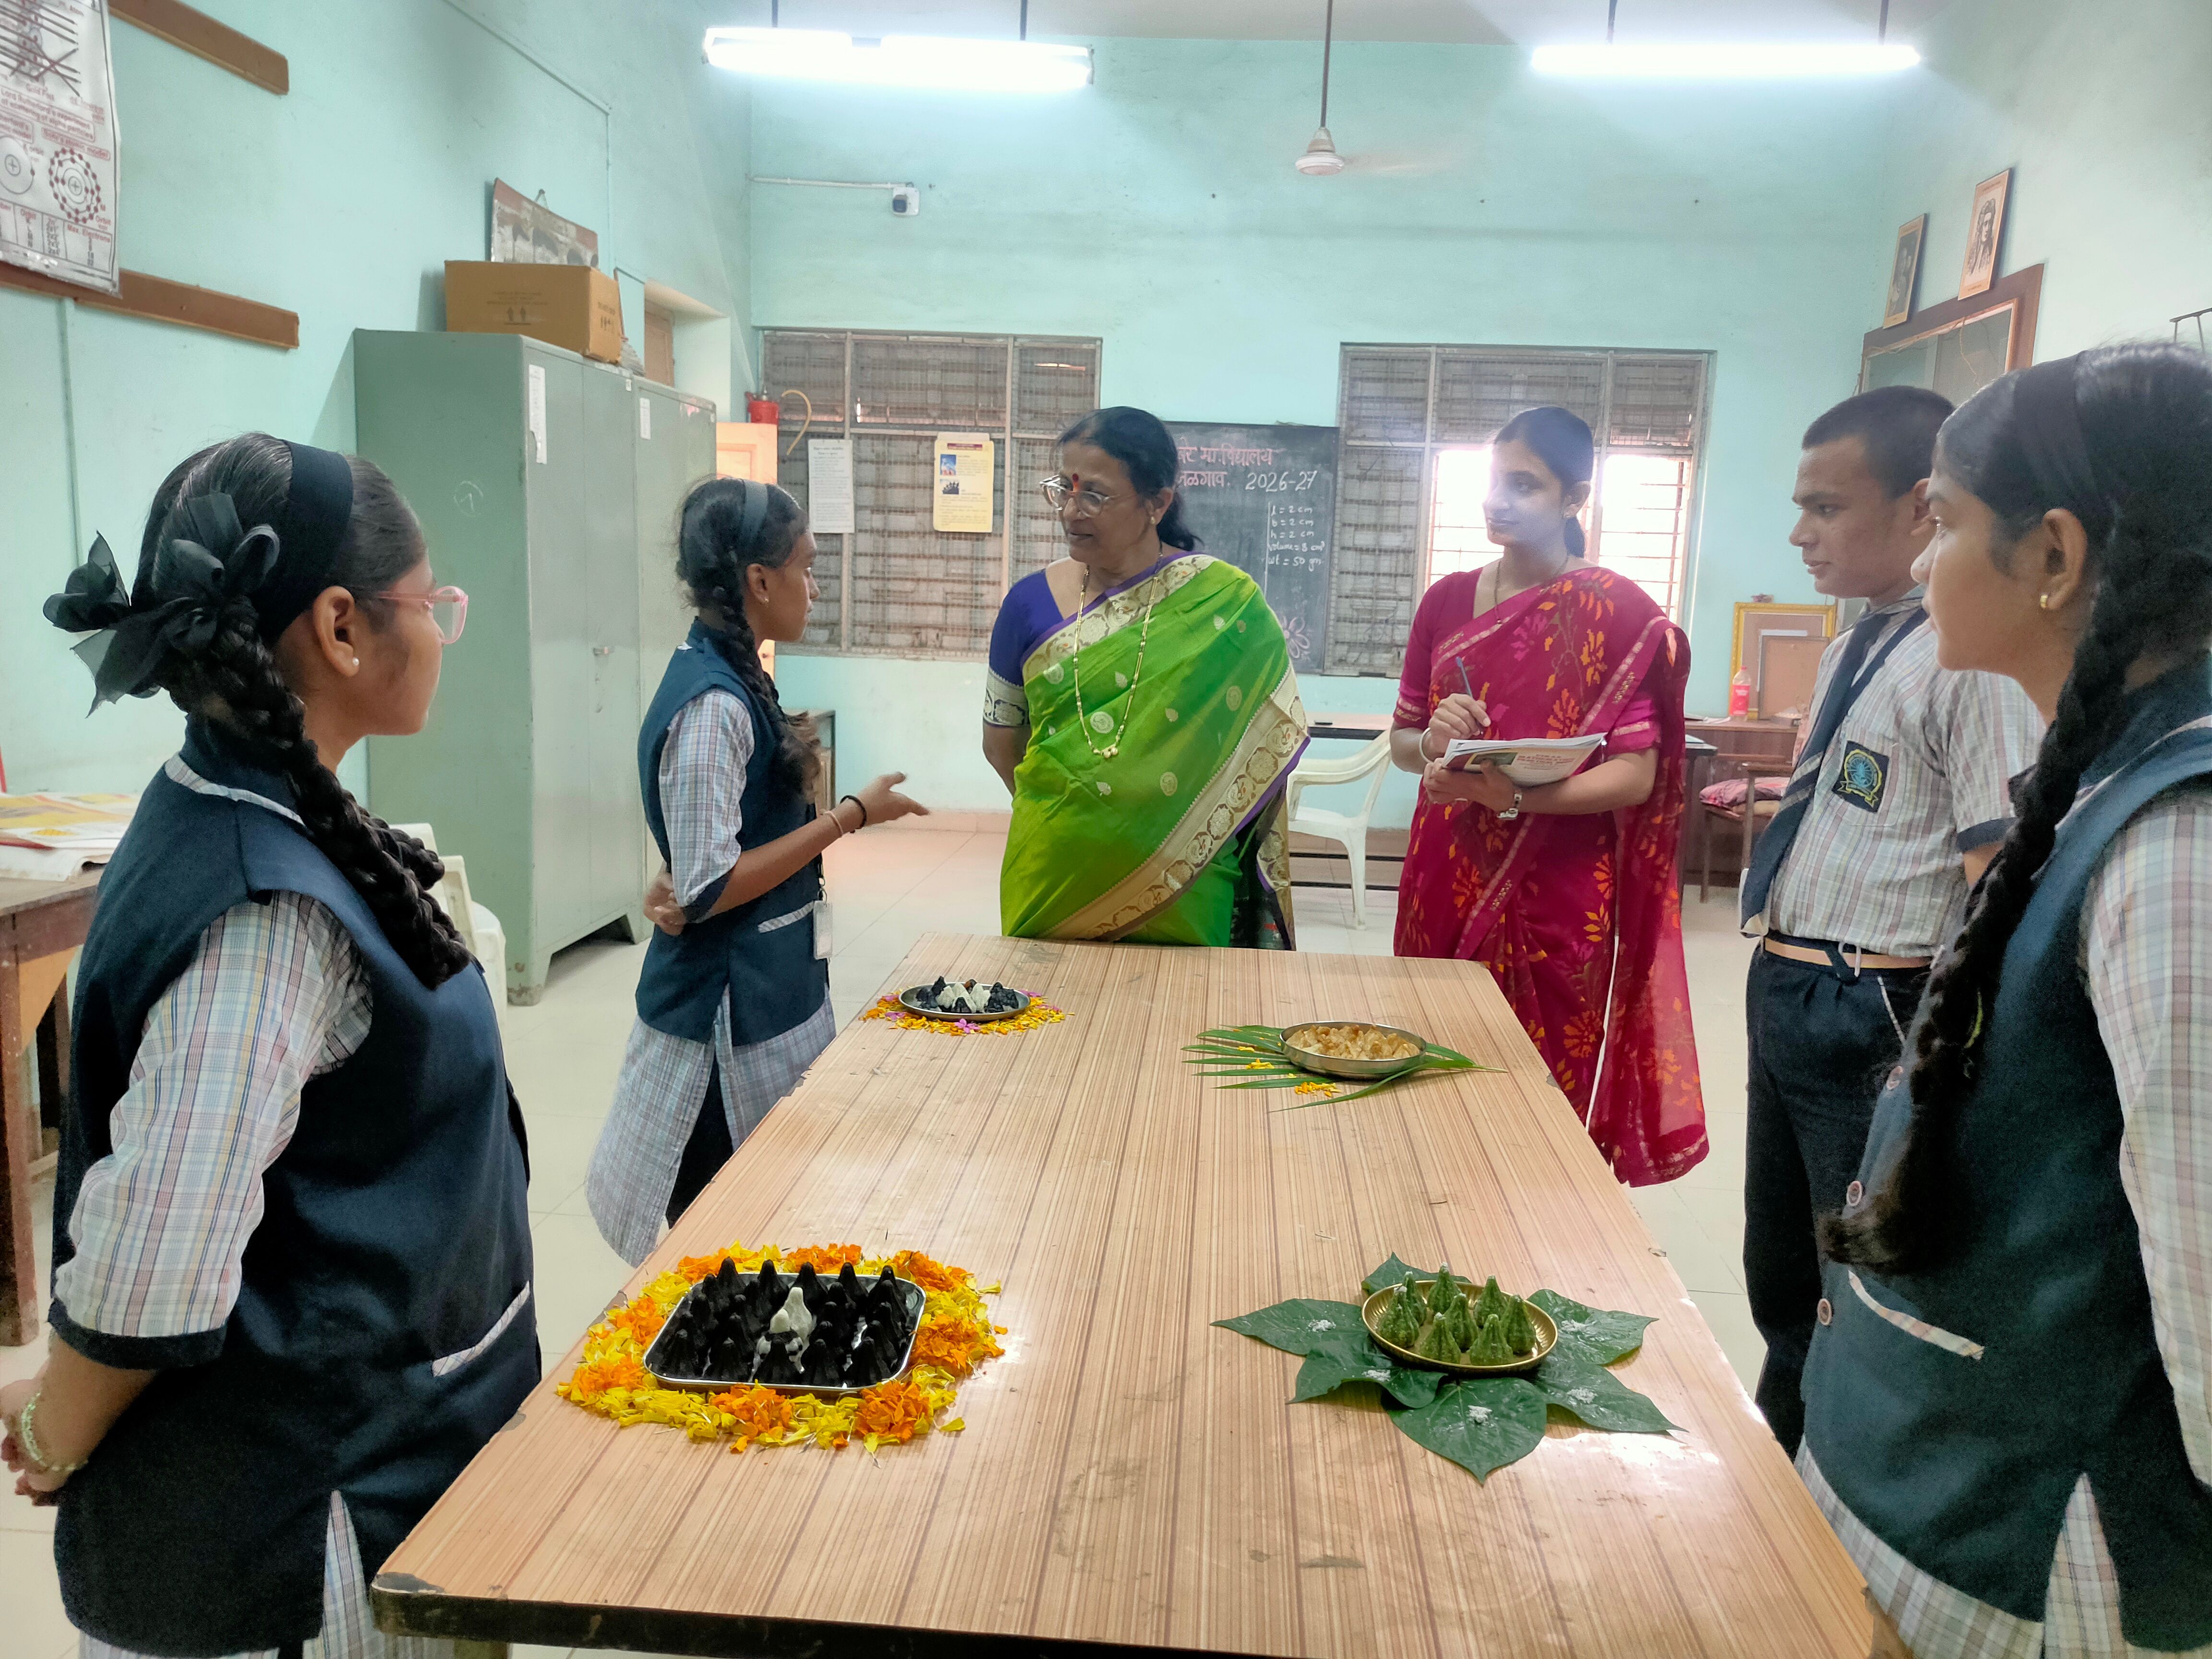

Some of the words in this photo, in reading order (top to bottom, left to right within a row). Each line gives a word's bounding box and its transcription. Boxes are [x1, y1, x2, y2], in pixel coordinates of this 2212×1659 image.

[1245, 470, 1318, 493] 2026-27
[1289, 505, 1296, 513] 2
[1270, 529, 1277, 539] h
[1292, 556, 1306, 566] 50
